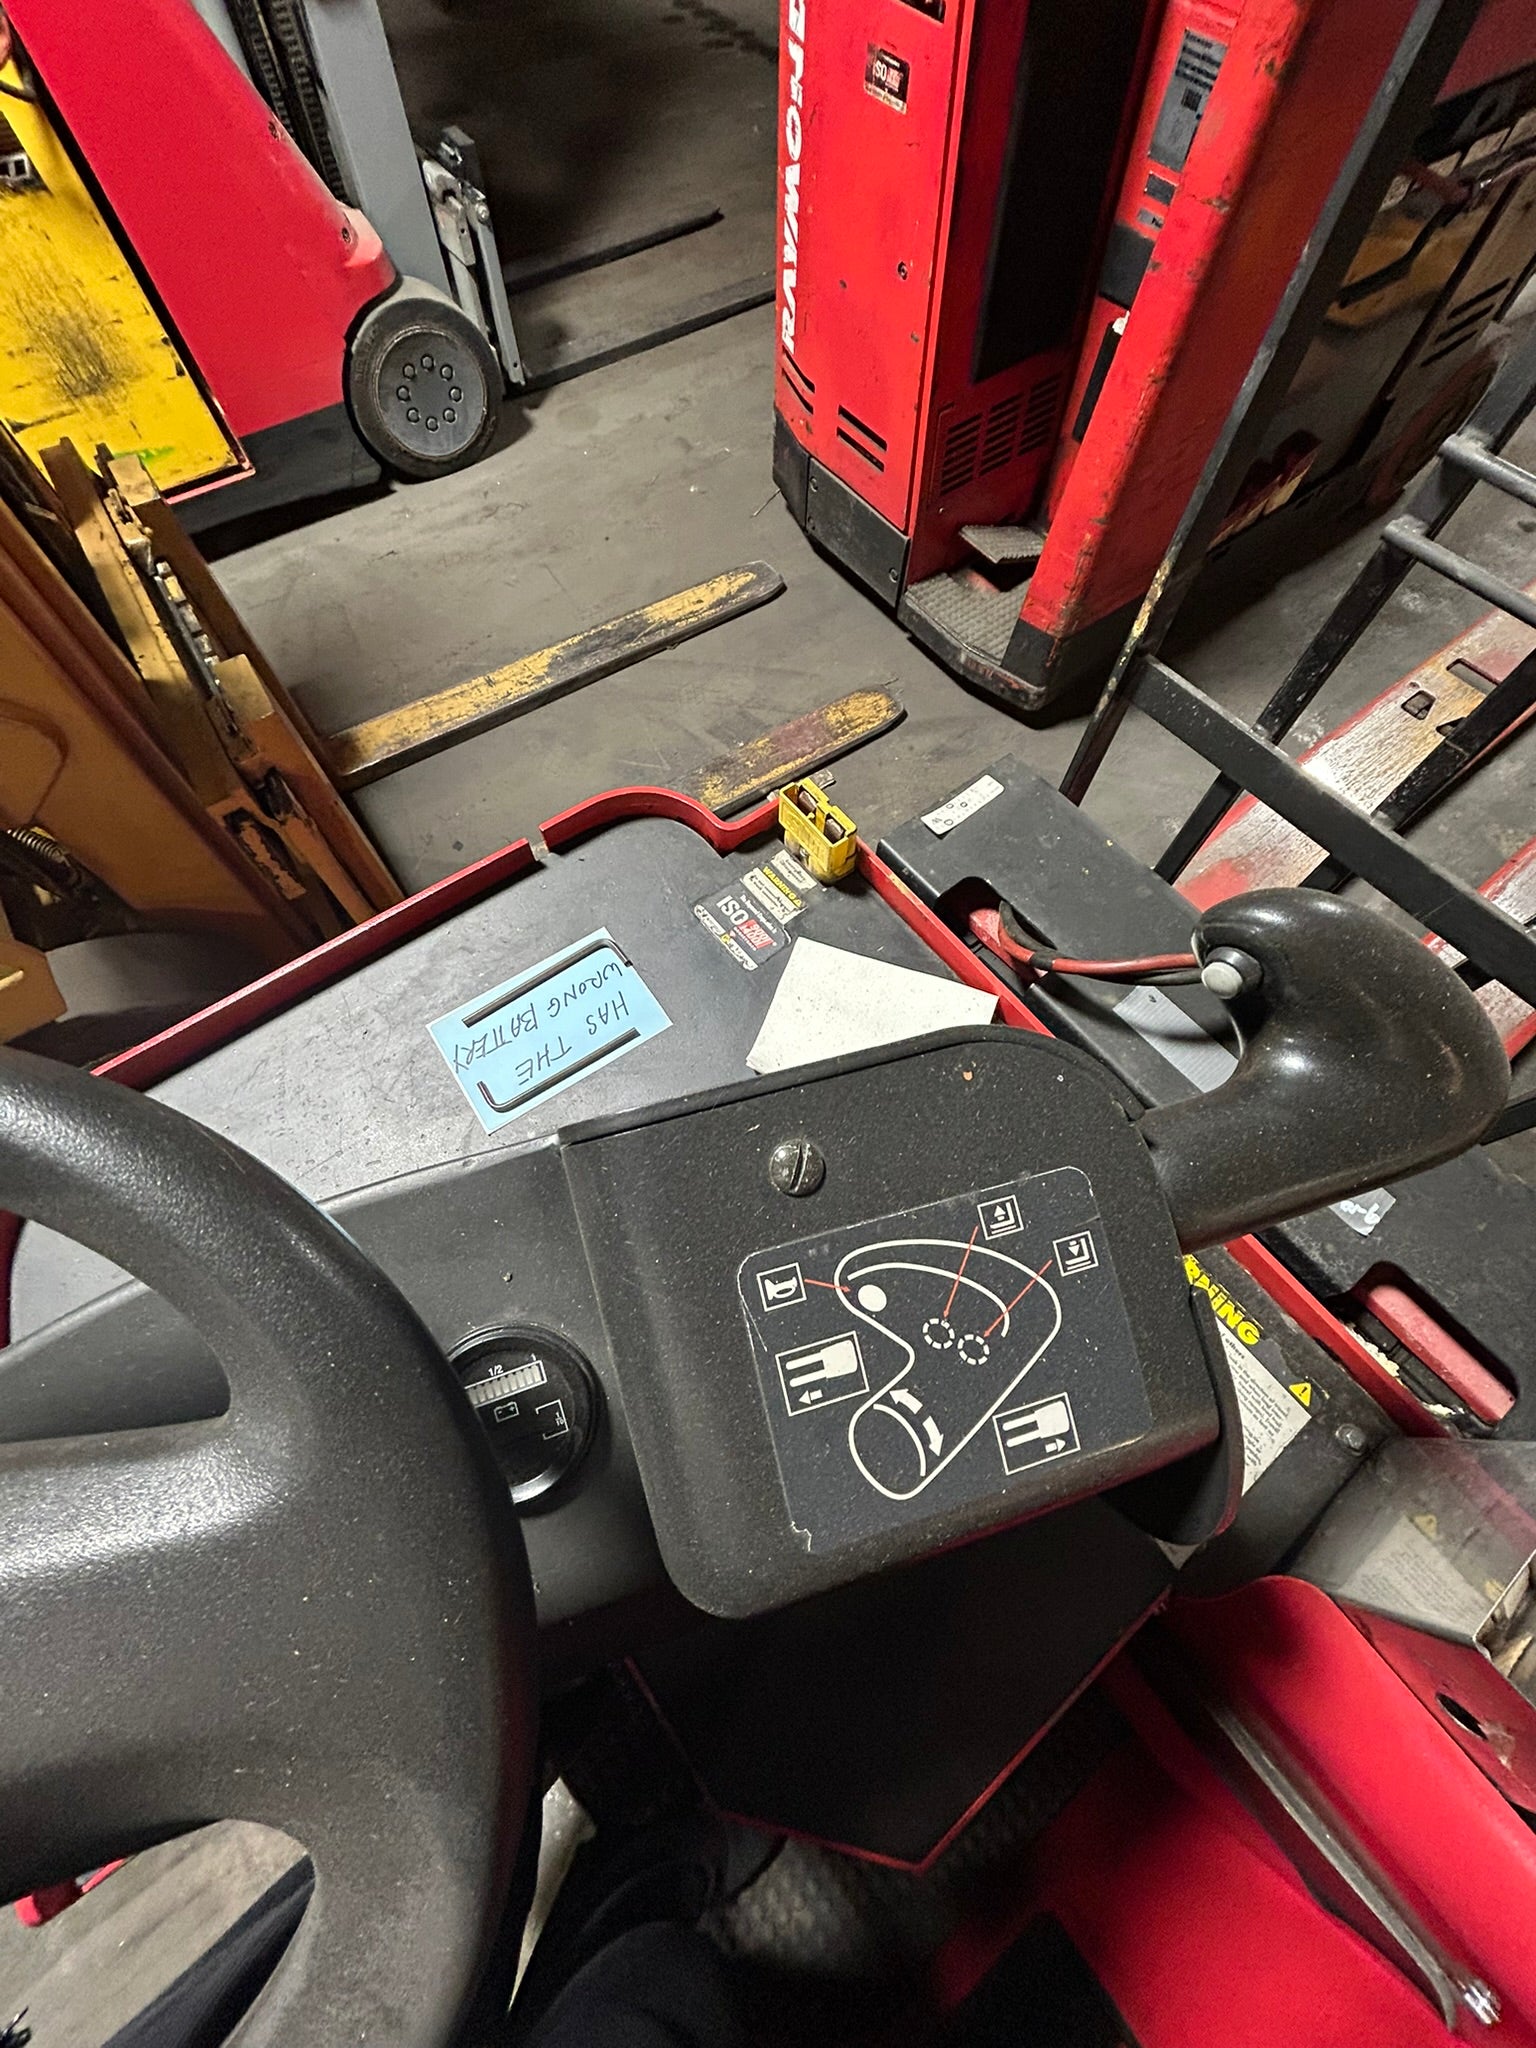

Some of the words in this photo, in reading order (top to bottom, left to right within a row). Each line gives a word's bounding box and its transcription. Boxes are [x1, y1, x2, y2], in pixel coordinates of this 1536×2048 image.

[762, 865, 797, 900] WARNING
[715, 894, 750, 926] ISO
[548, 963, 622, 1016] WRONG
[587, 990, 630, 1035] HAS
[455, 1002, 537, 1073] BATTERY
[515, 1035, 572, 1085] THE
[488, 1364, 504, 1376] 1/2
